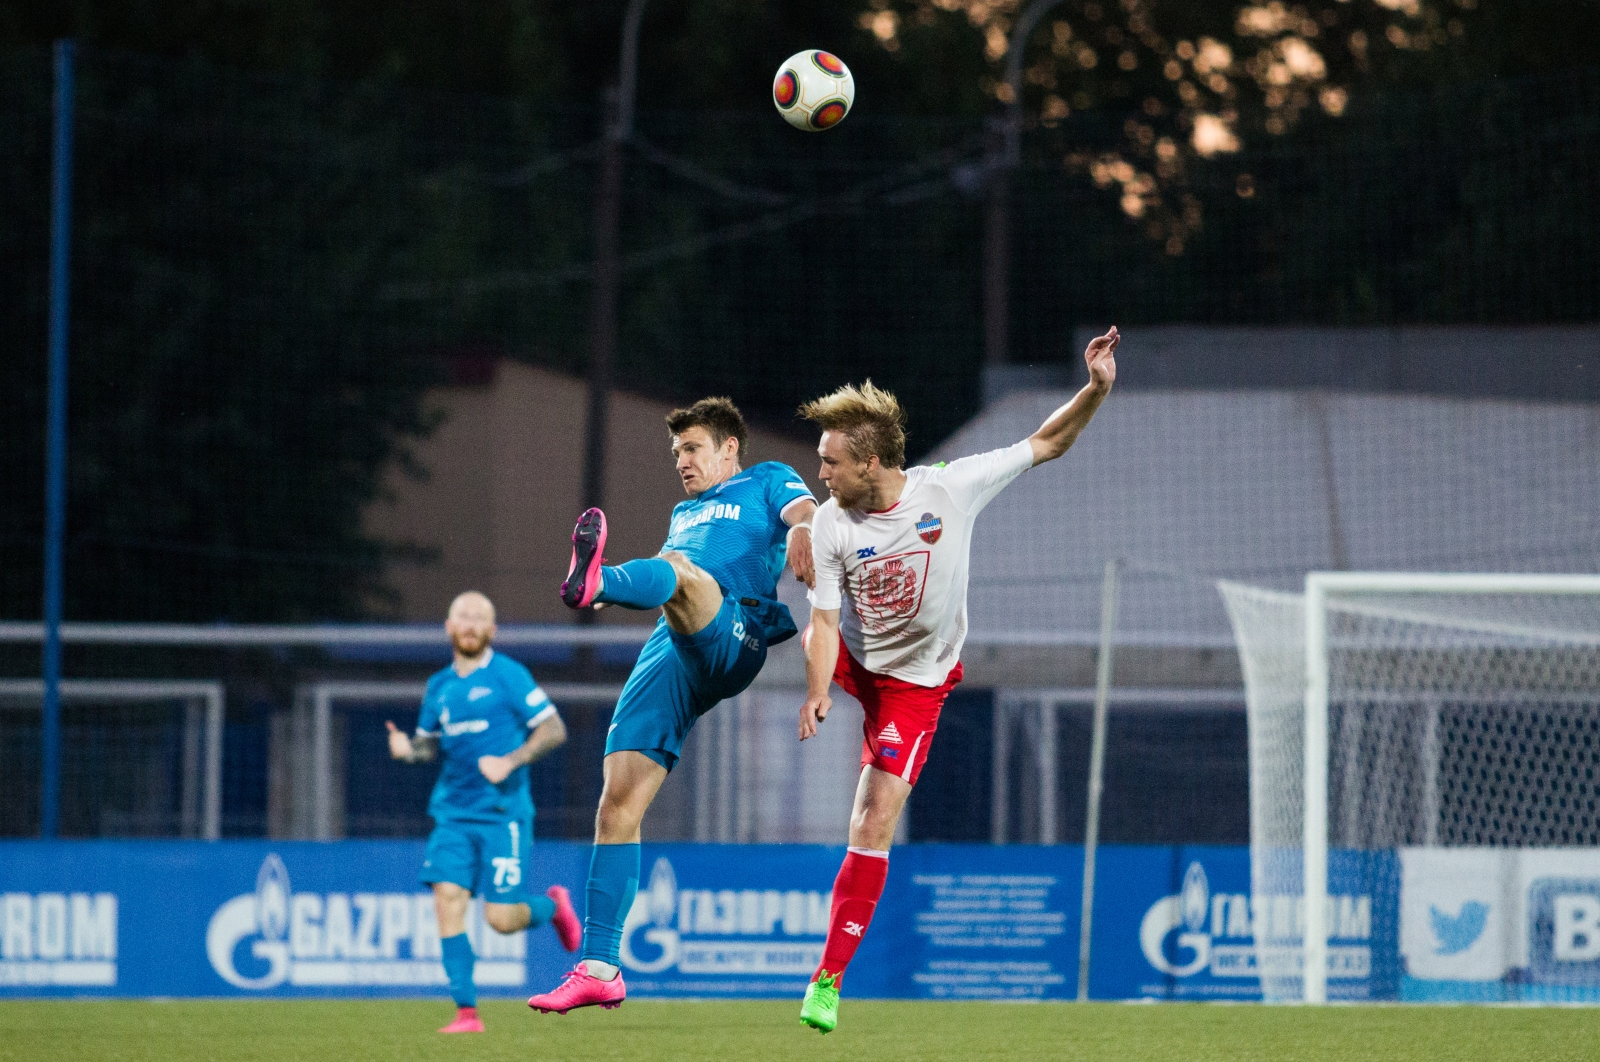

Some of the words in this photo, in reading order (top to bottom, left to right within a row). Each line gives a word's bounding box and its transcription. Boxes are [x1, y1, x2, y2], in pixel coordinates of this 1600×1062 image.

[857, 546, 877, 559] 2K
[492, 857, 521, 886] 75
[842, 921, 864, 937] 2K
